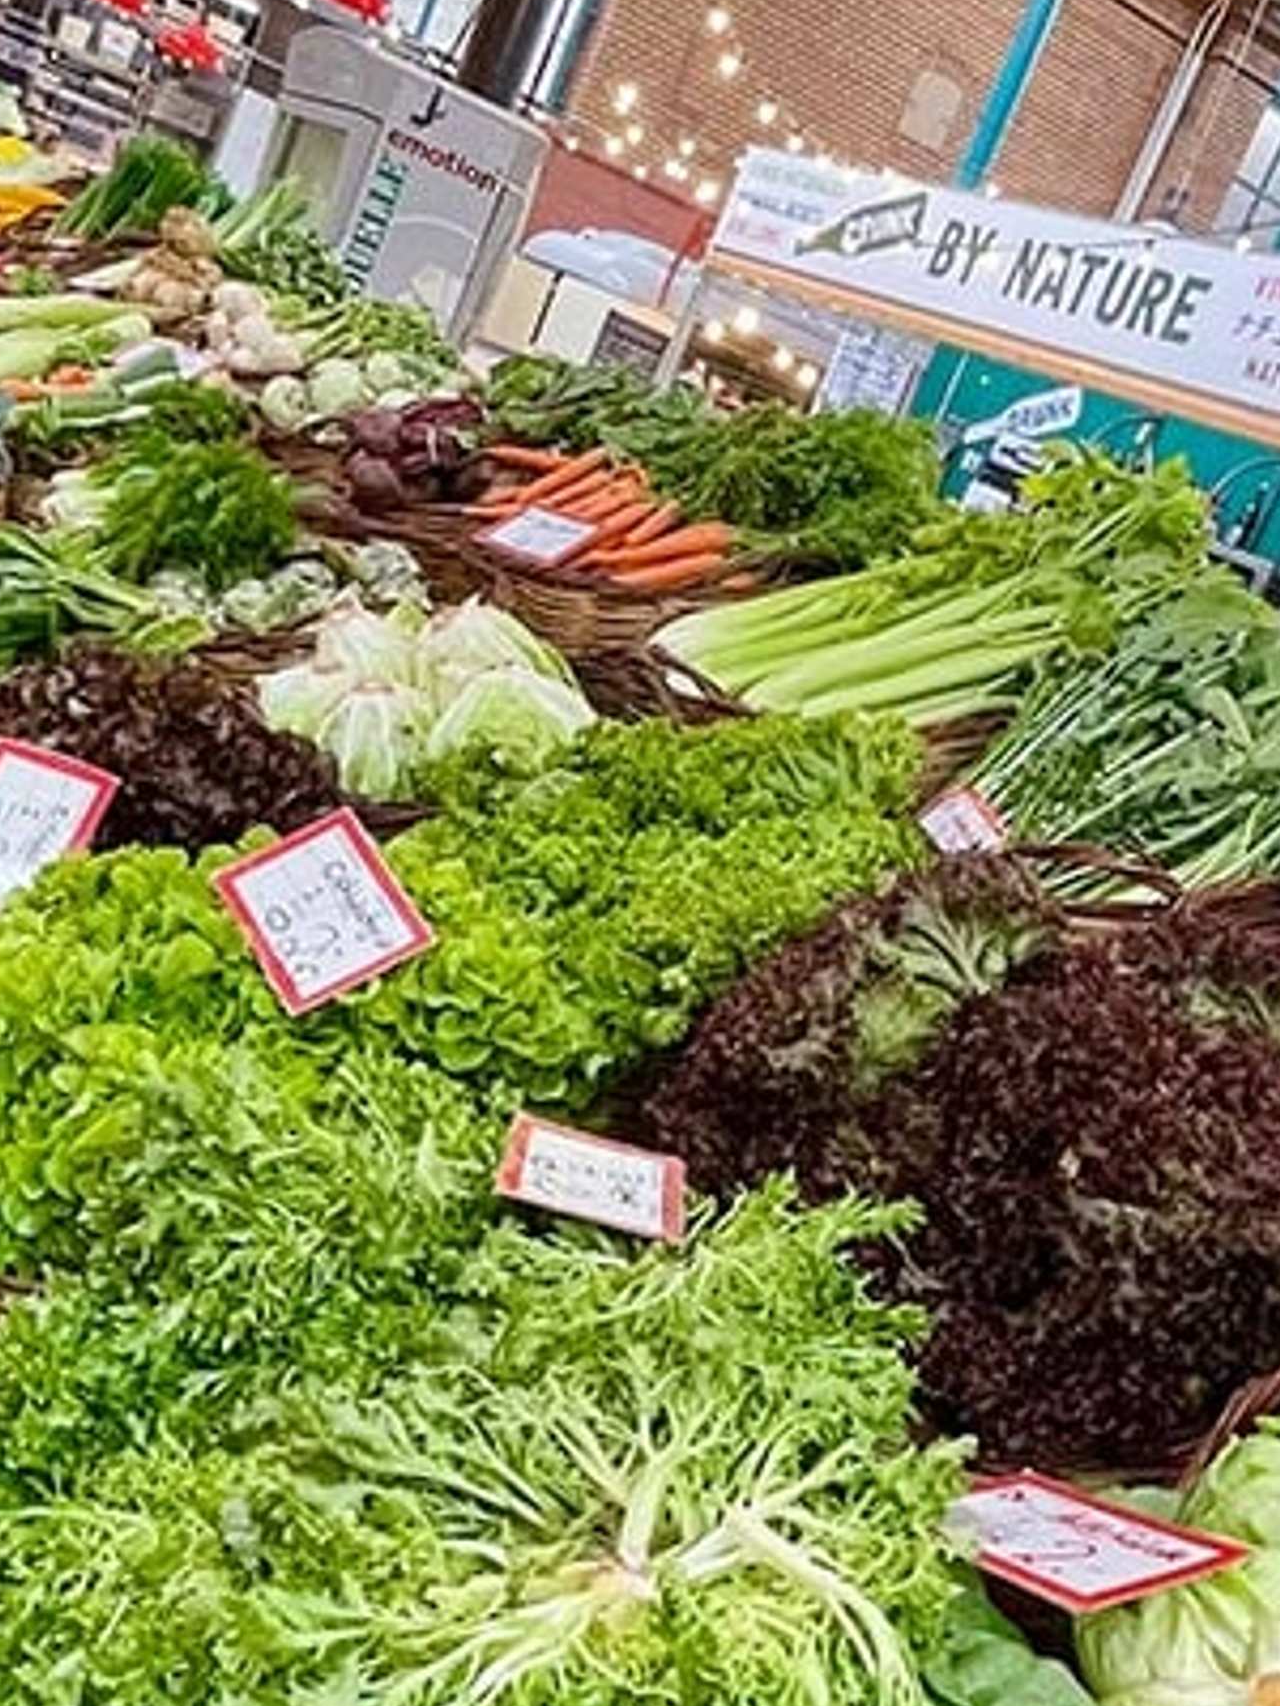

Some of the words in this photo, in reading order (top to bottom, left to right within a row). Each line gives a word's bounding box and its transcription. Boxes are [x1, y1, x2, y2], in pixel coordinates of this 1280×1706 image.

[387, 129, 499, 192] emotion
[927, 219, 997, 287] BY
[1002, 236, 1214, 346] NATURE
